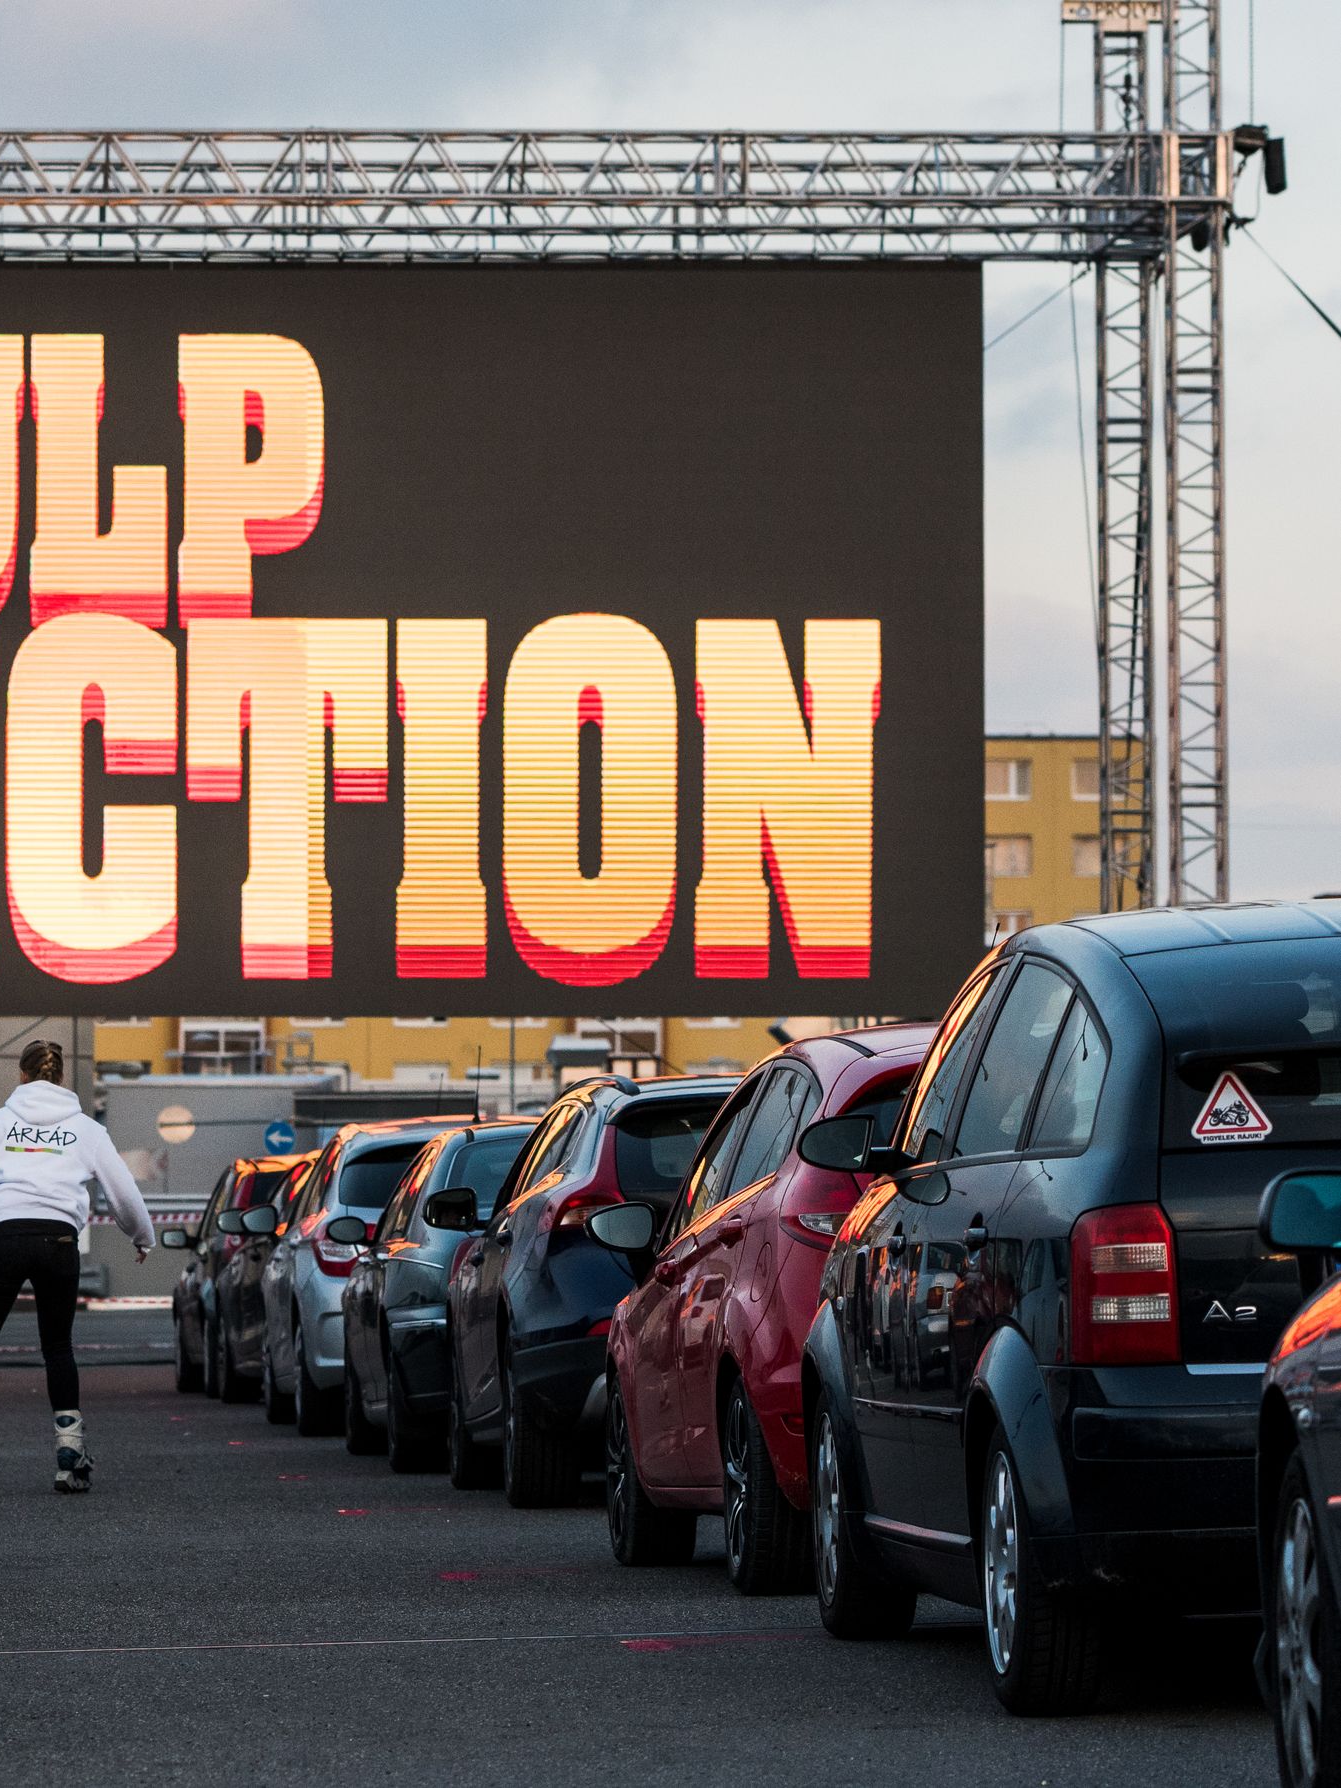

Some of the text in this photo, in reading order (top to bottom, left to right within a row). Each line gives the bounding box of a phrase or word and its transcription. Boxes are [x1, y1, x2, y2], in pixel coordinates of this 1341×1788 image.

[1095, 2, 1159, 18] PROLYT
[7, 1121, 77, 1146] ÁRKÁD
[1203, 1134, 1236, 1142] FIGYELEK
[1202, 1300, 1257, 1322] A2
